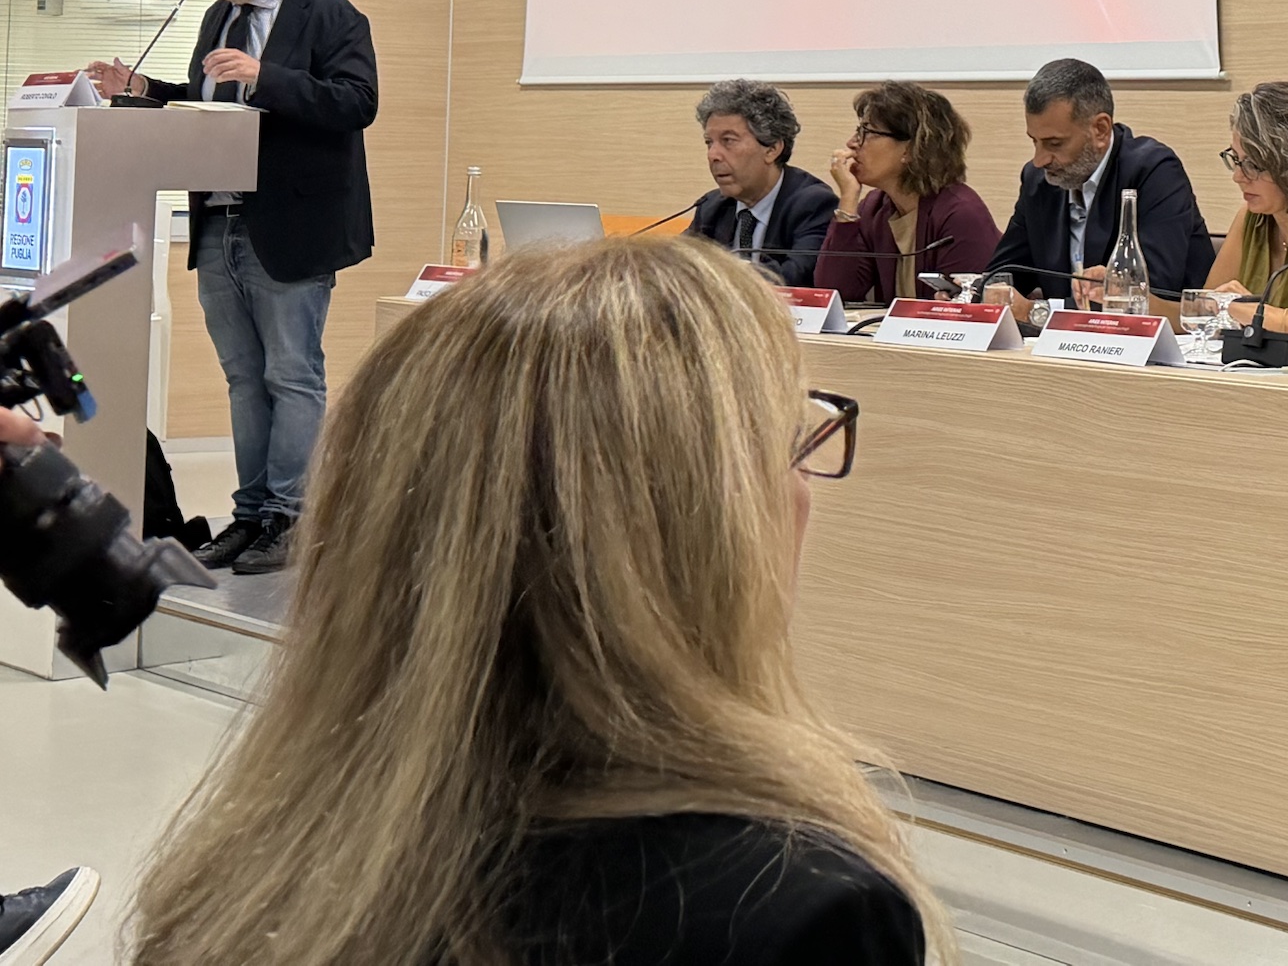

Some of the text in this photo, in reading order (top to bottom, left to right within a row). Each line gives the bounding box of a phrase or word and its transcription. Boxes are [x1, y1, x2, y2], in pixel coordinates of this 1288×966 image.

[10, 233, 35, 247] REGIONE
[10, 247, 32, 260] PUGLIA
[903, 329, 965, 342] MARINA LEUZZI
[1058, 342, 1124, 356] MARCO RANIERI
